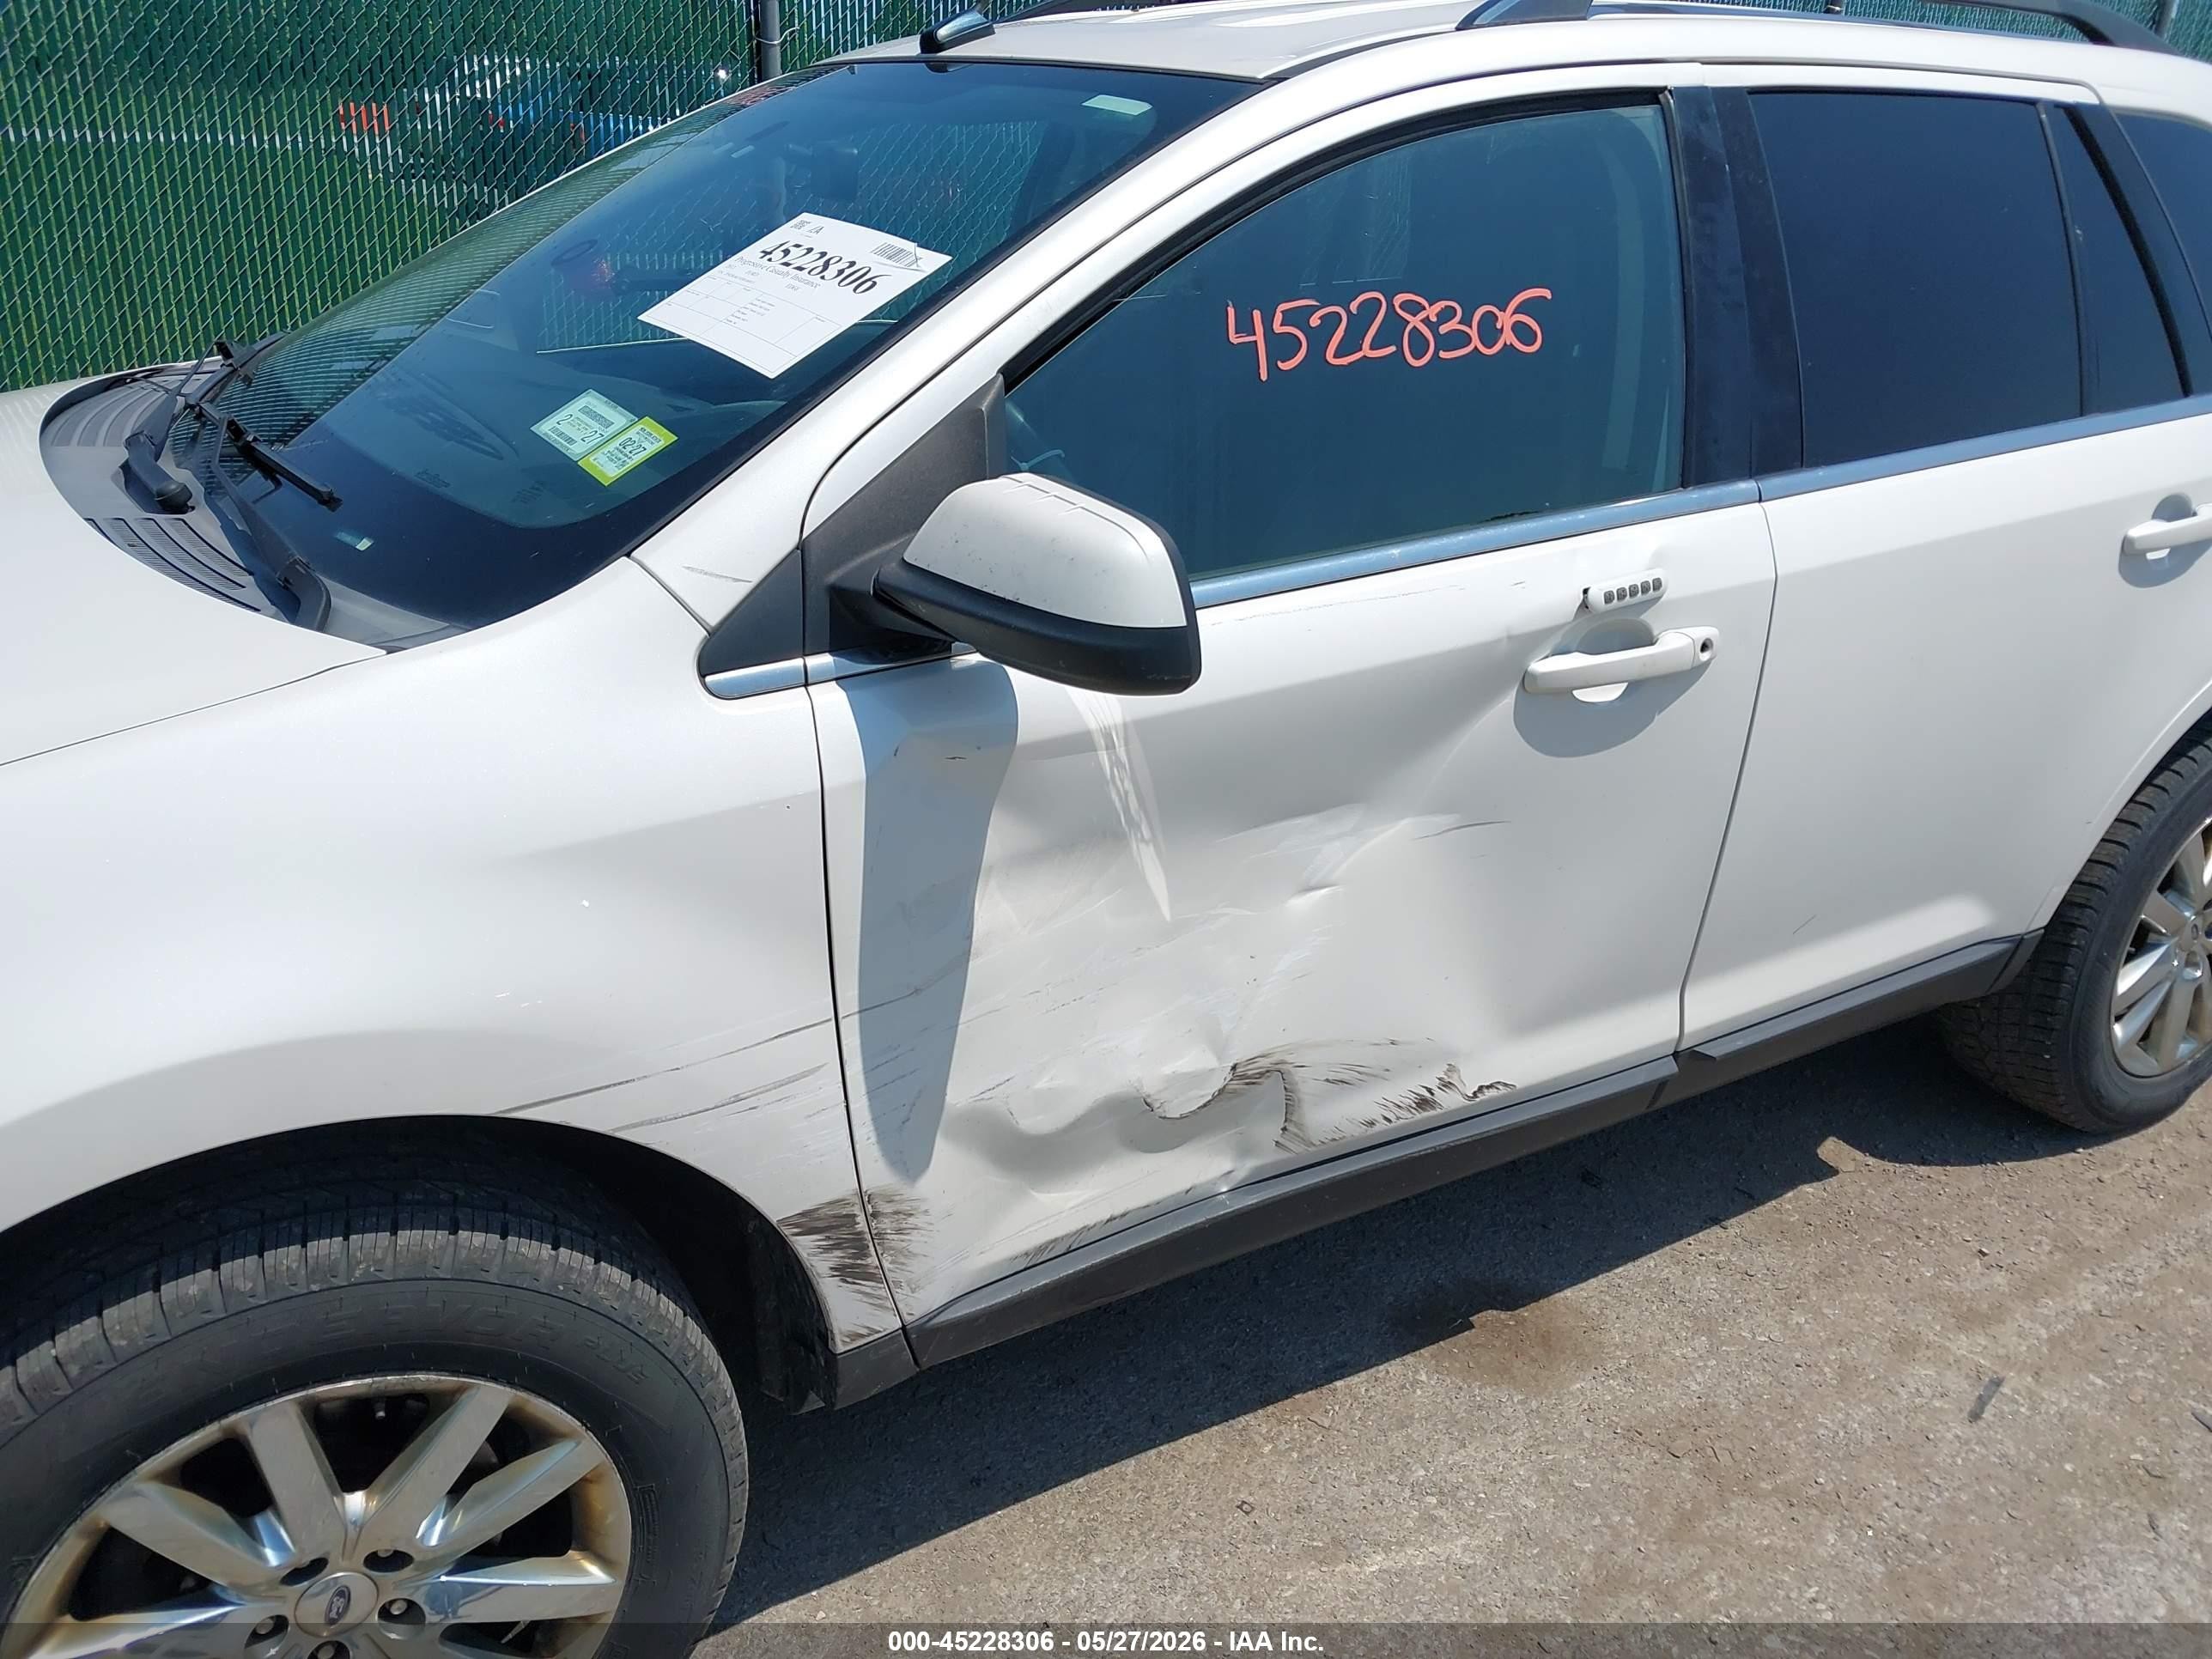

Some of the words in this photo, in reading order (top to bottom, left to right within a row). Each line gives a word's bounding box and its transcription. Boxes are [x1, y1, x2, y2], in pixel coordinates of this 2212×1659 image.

[758, 240, 892, 295] 45228306
[1226, 287, 1552, 381] 45228306
[556, 413, 574, 426] 2
[580, 428, 605, 445] 27
